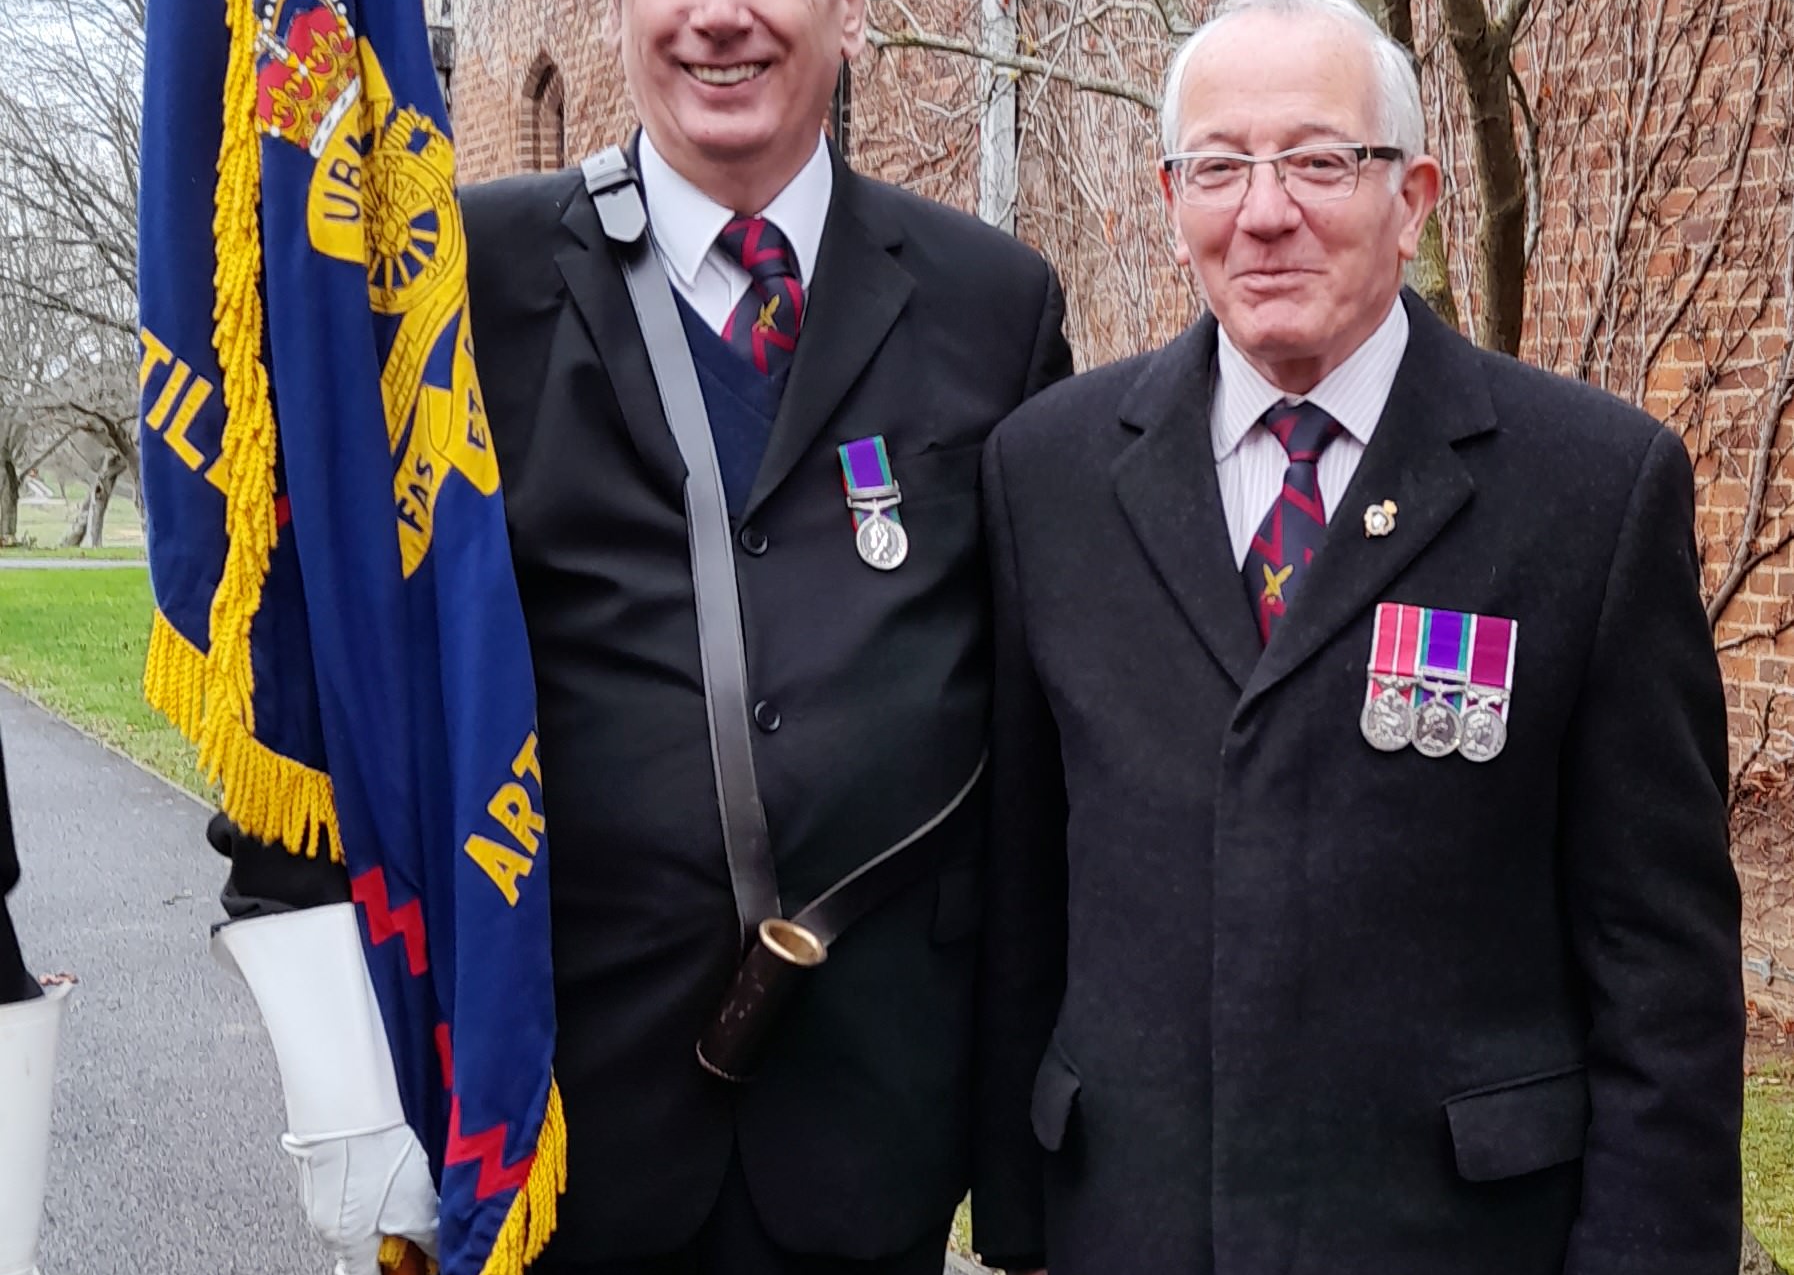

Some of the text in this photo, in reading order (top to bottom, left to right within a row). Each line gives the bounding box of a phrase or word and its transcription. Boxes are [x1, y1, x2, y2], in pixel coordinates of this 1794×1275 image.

[139, 325, 230, 498] TIL
[397, 452, 433, 534] FAS
[463, 729, 546, 908] ART
